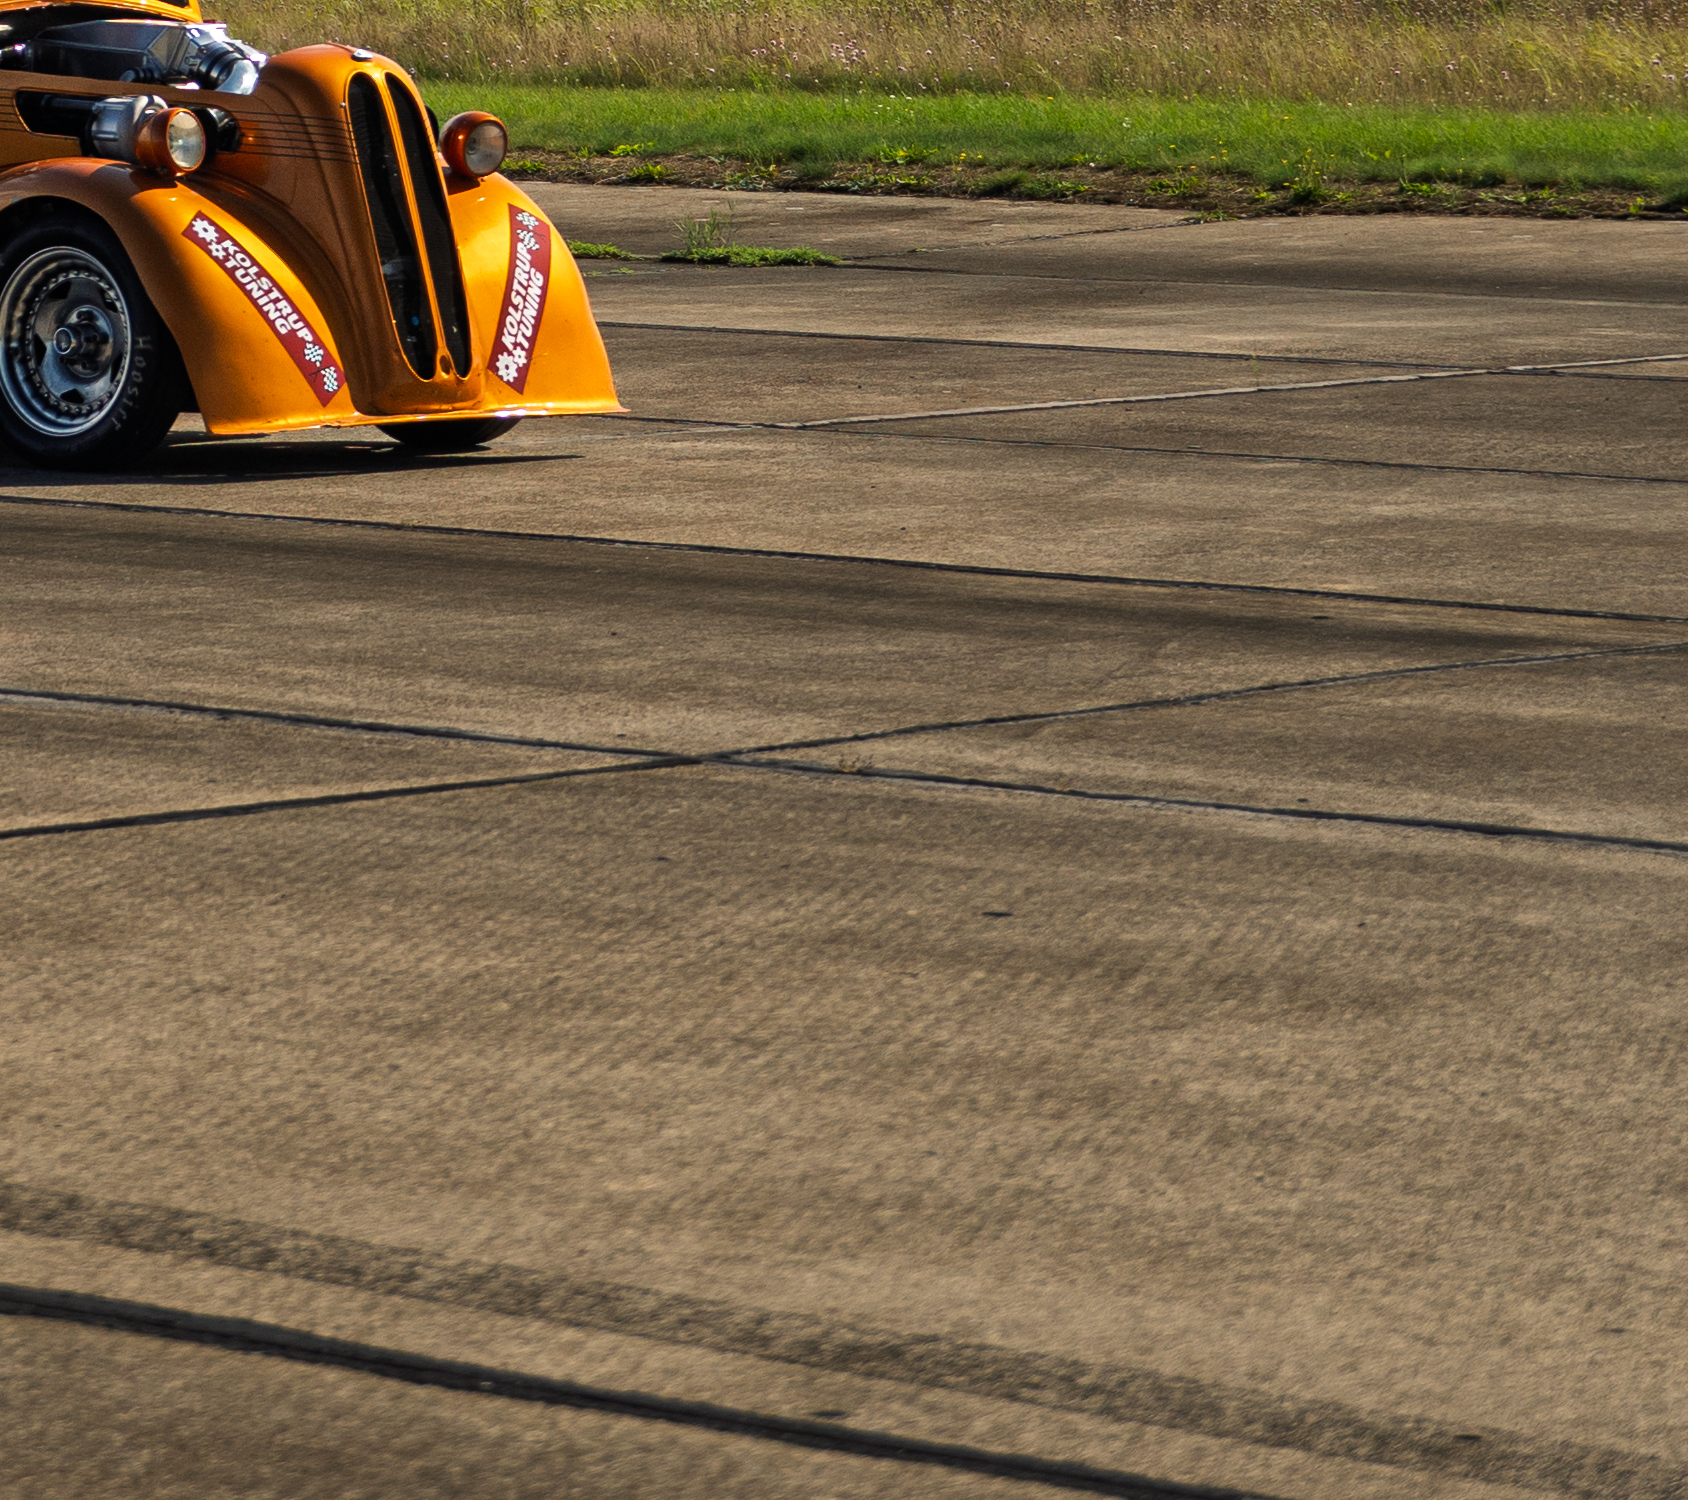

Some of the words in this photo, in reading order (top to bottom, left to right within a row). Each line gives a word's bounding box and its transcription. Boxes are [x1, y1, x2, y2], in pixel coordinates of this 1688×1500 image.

[221, 240, 313, 342] KOLSTRUP
[225, 255, 292, 335] TUNING
[501, 241, 532, 350] KOLSTRUP
[516, 267, 544, 349] TUNING
